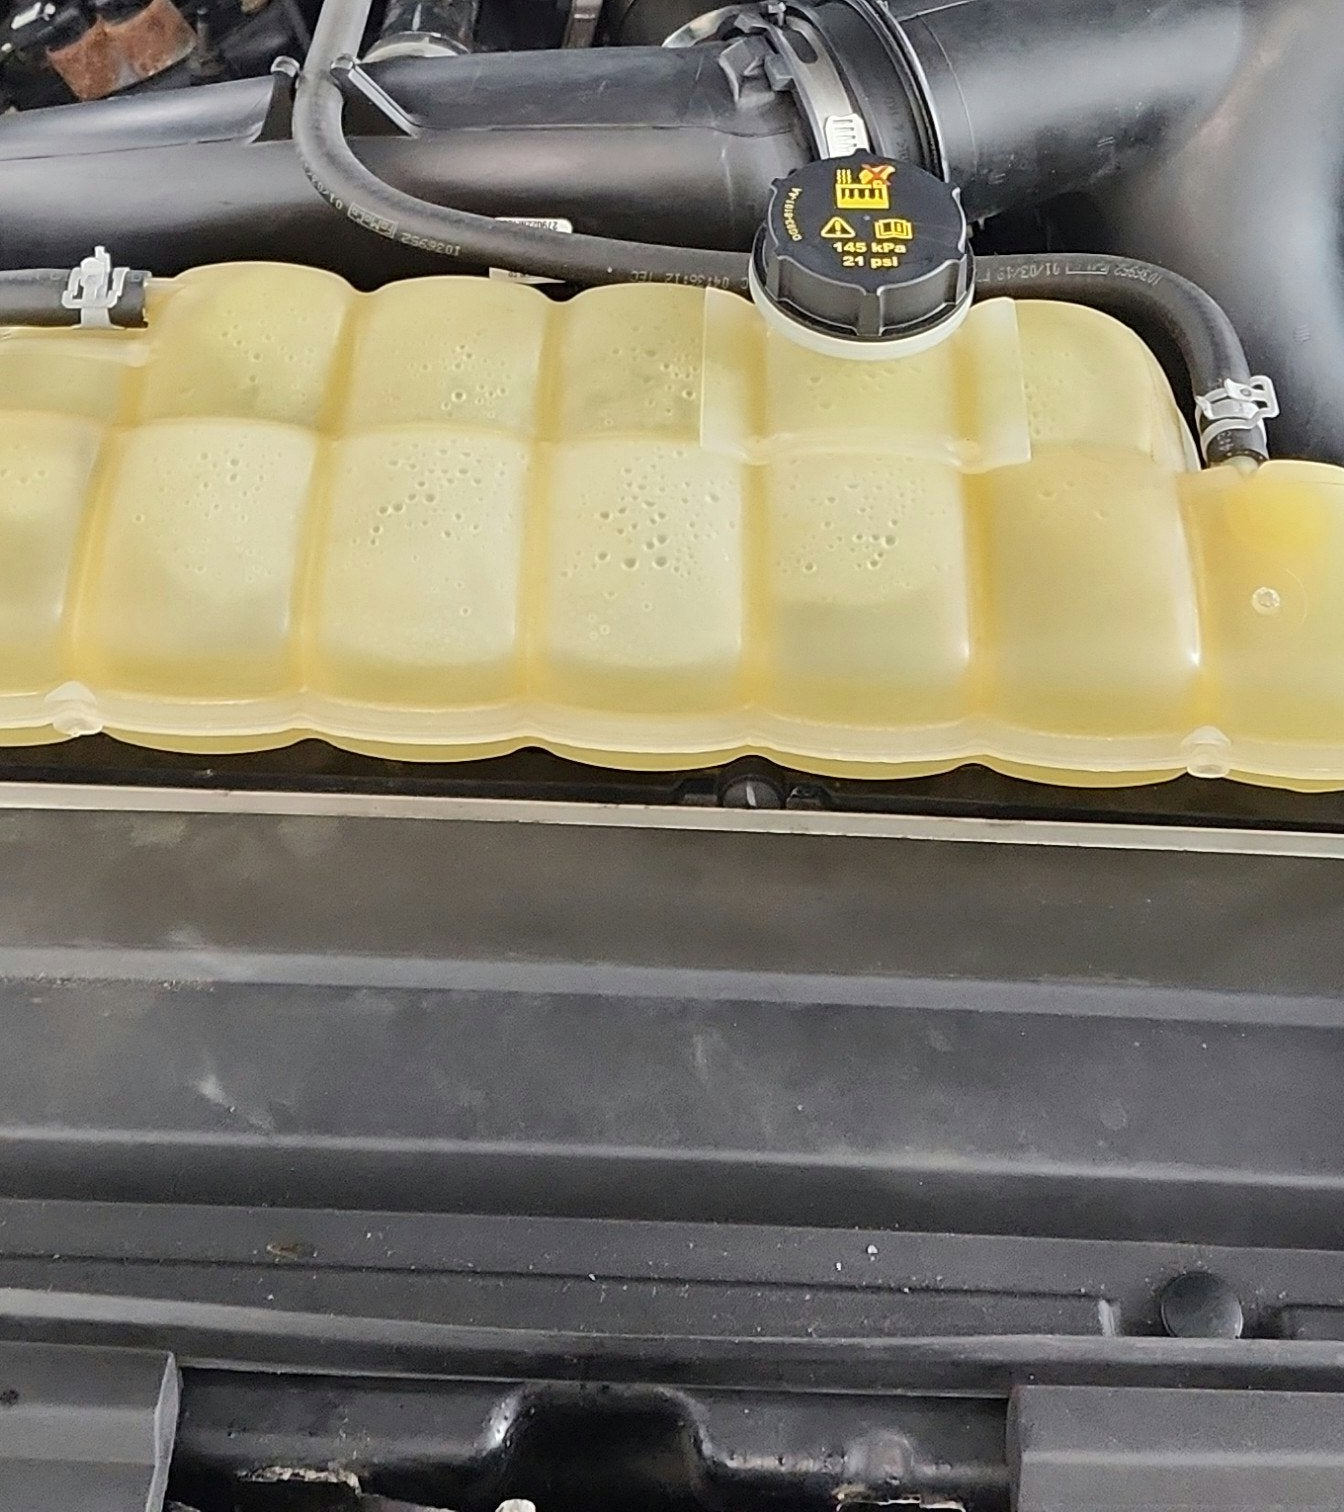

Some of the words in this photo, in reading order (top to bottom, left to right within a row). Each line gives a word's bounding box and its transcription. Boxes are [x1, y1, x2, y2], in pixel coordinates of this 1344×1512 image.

[833, 241, 868, 253] 145
[871, 241, 907, 254] kPa
[842, 255, 865, 267] 21
[870, 255, 899, 269] psi
